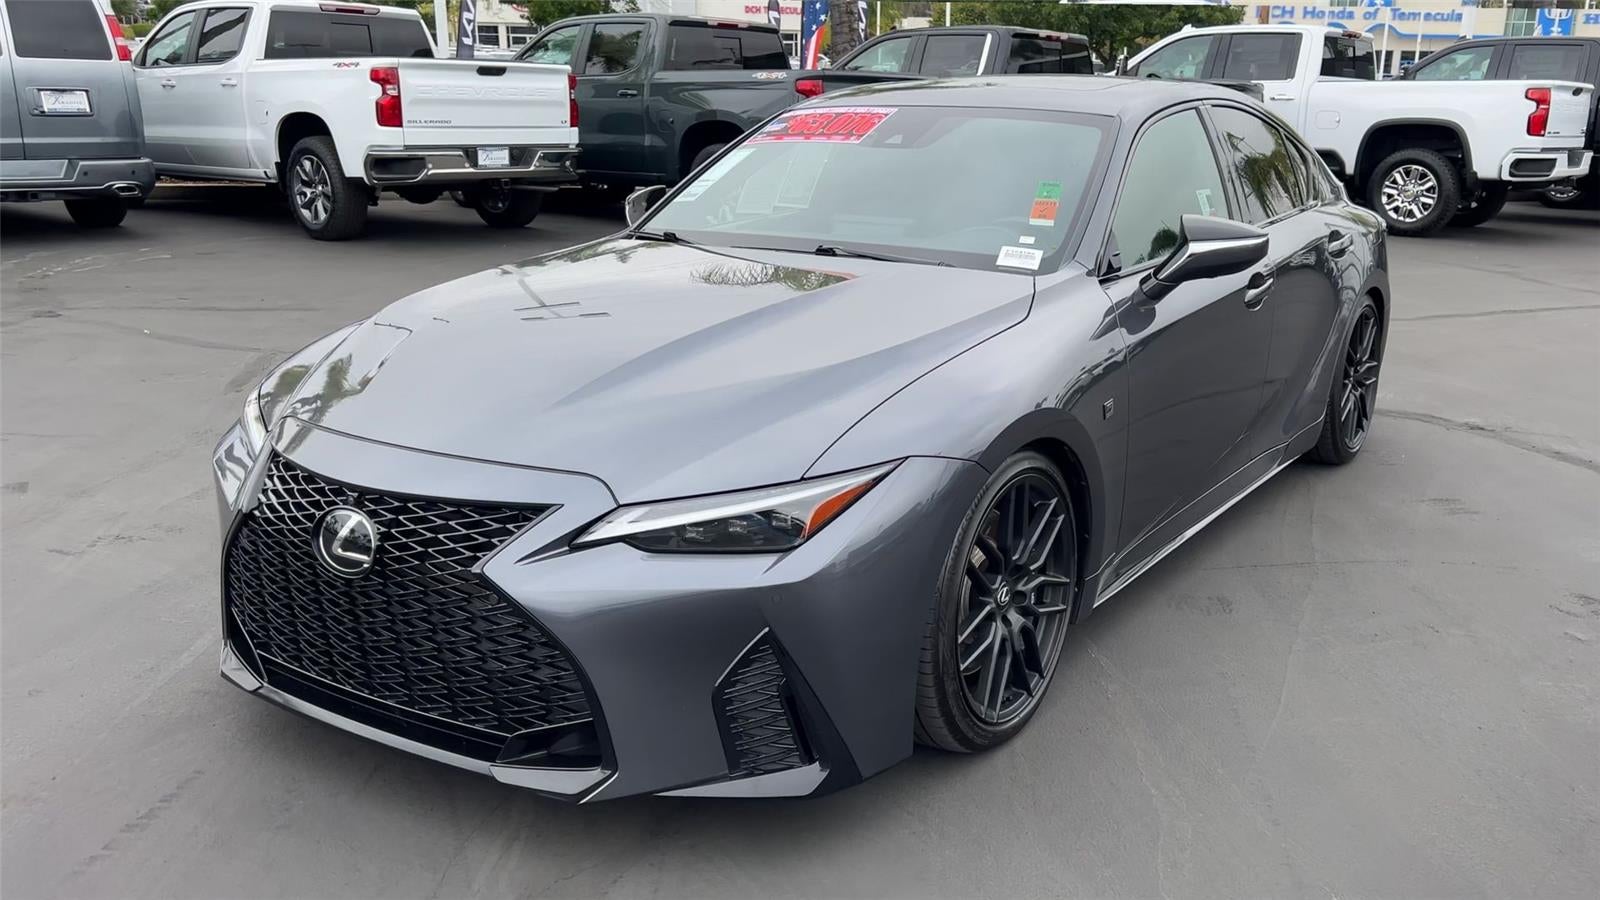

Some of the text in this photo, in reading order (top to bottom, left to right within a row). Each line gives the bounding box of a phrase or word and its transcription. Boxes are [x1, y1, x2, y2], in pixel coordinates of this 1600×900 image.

[744, 5, 761, 14] DCH
[1302, 6, 1355, 20] Honda
[1363, 8, 1380, 20] of
[1390, 8, 1463, 22] Temecula
